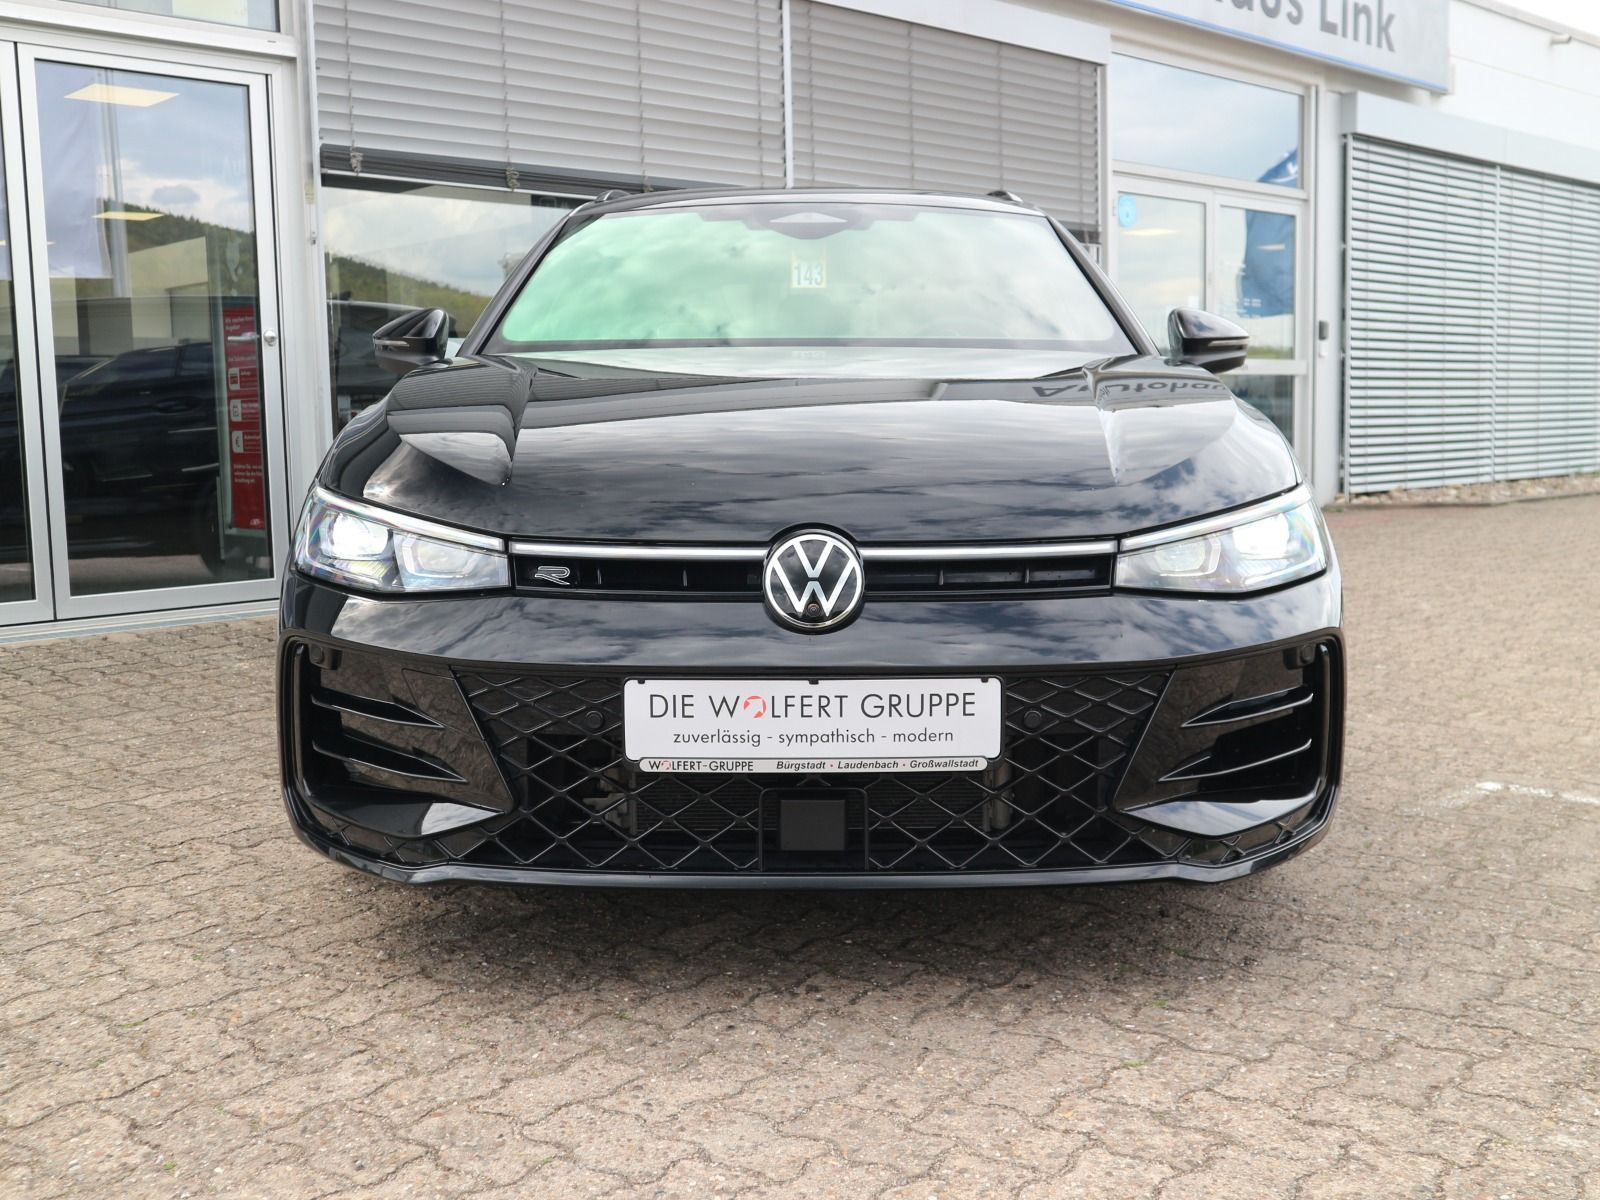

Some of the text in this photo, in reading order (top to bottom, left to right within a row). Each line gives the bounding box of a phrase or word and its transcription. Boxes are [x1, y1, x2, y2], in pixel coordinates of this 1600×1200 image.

[1319, 0, 1396, 52] Link
[793, 262, 824, 286] 143
[649, 692, 976, 719] DIE WOLFERT GRUPPE
[673, 728, 761, 748] zuverlässig
[778, 728, 875, 748] sympathisch
[892, 727, 954, 743] modern
[648, 759, 980, 773] WOLFERT-GRUPPE Bürgstadt Laudenbach Großwallstadt
